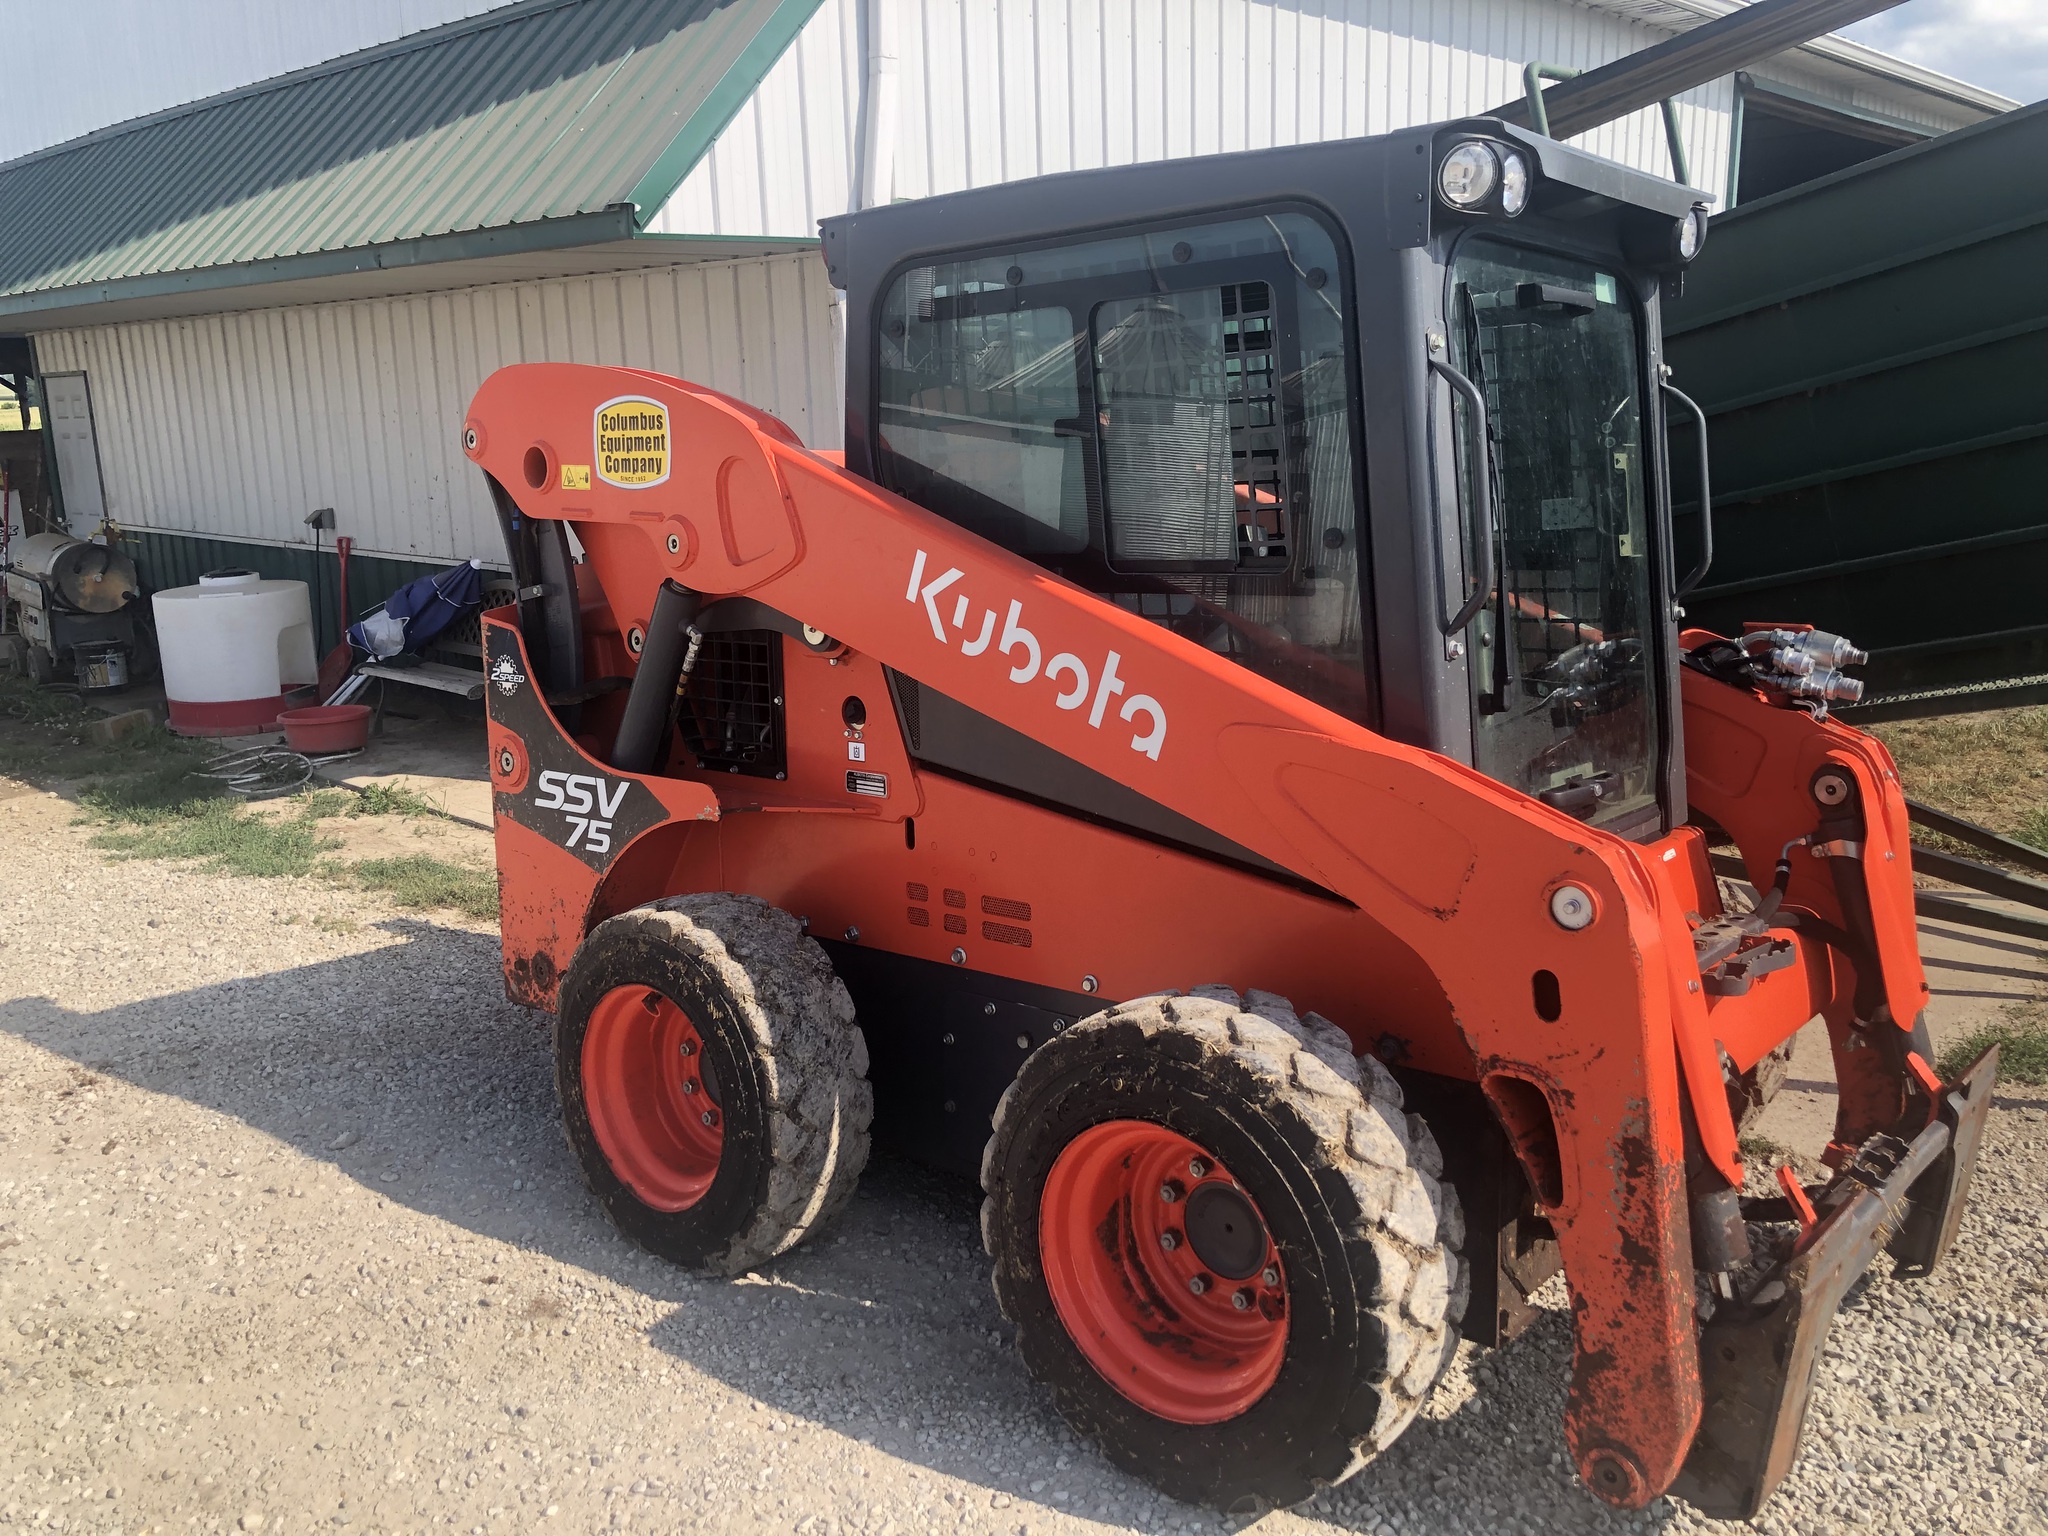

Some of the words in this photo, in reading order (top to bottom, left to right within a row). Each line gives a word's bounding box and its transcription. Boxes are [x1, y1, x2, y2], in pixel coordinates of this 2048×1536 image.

[601, 412, 663, 432] Columbus
[600, 434, 666, 454] Equipment
[605, 455, 662, 475] Company
[906, 548, 1167, 762] Kubota
[534, 769, 631, 819] SSV
[565, 815, 613, 854] 75
